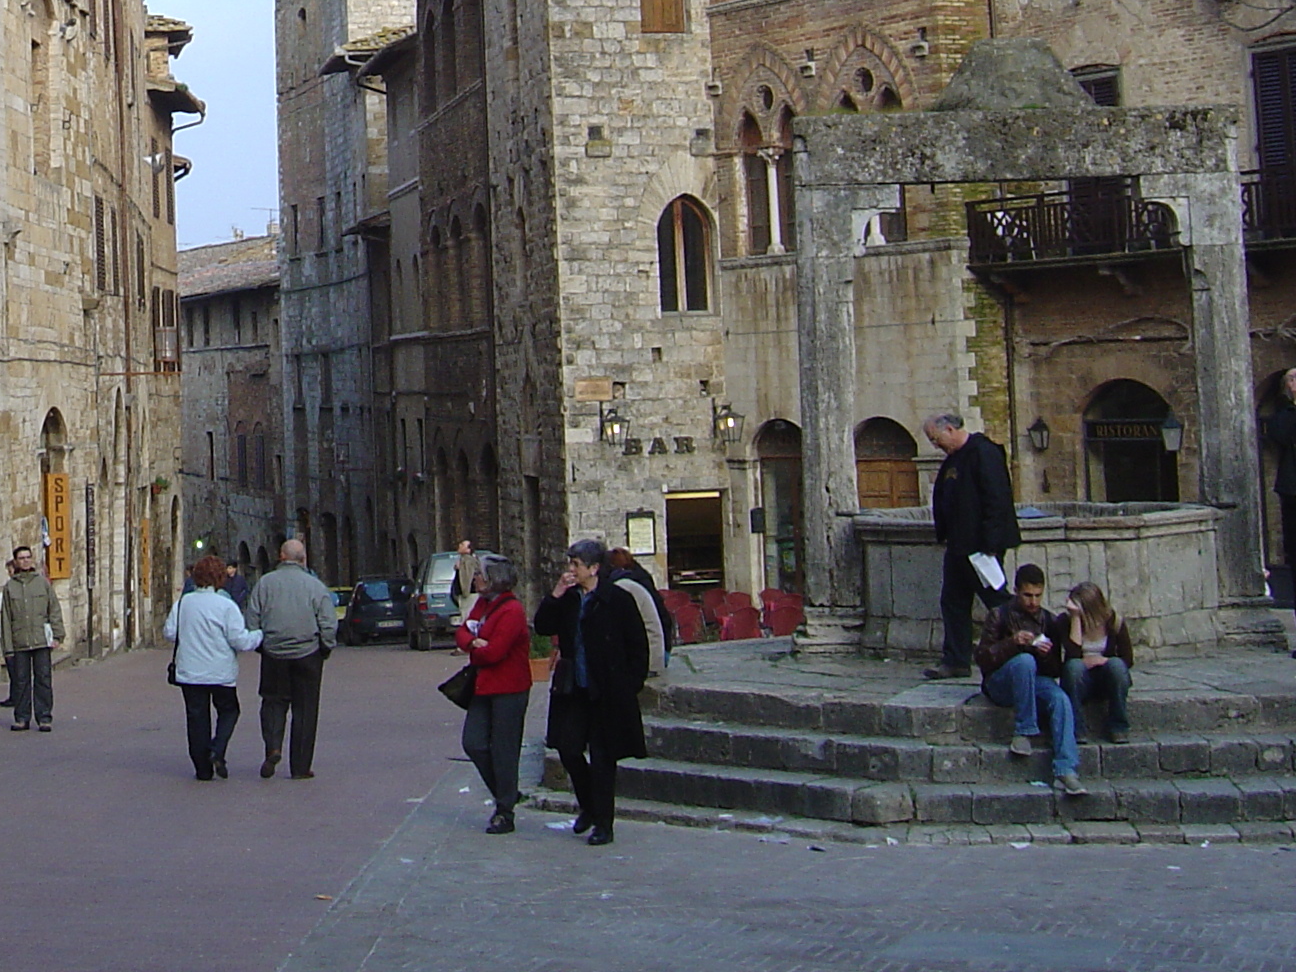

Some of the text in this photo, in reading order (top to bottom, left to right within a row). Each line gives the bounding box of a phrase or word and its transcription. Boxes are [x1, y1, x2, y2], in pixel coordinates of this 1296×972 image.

[1095, 424, 1158, 437] RISTORAN
[622, 436, 696, 455] BAR
[54, 477, 65, 572] SPORT
